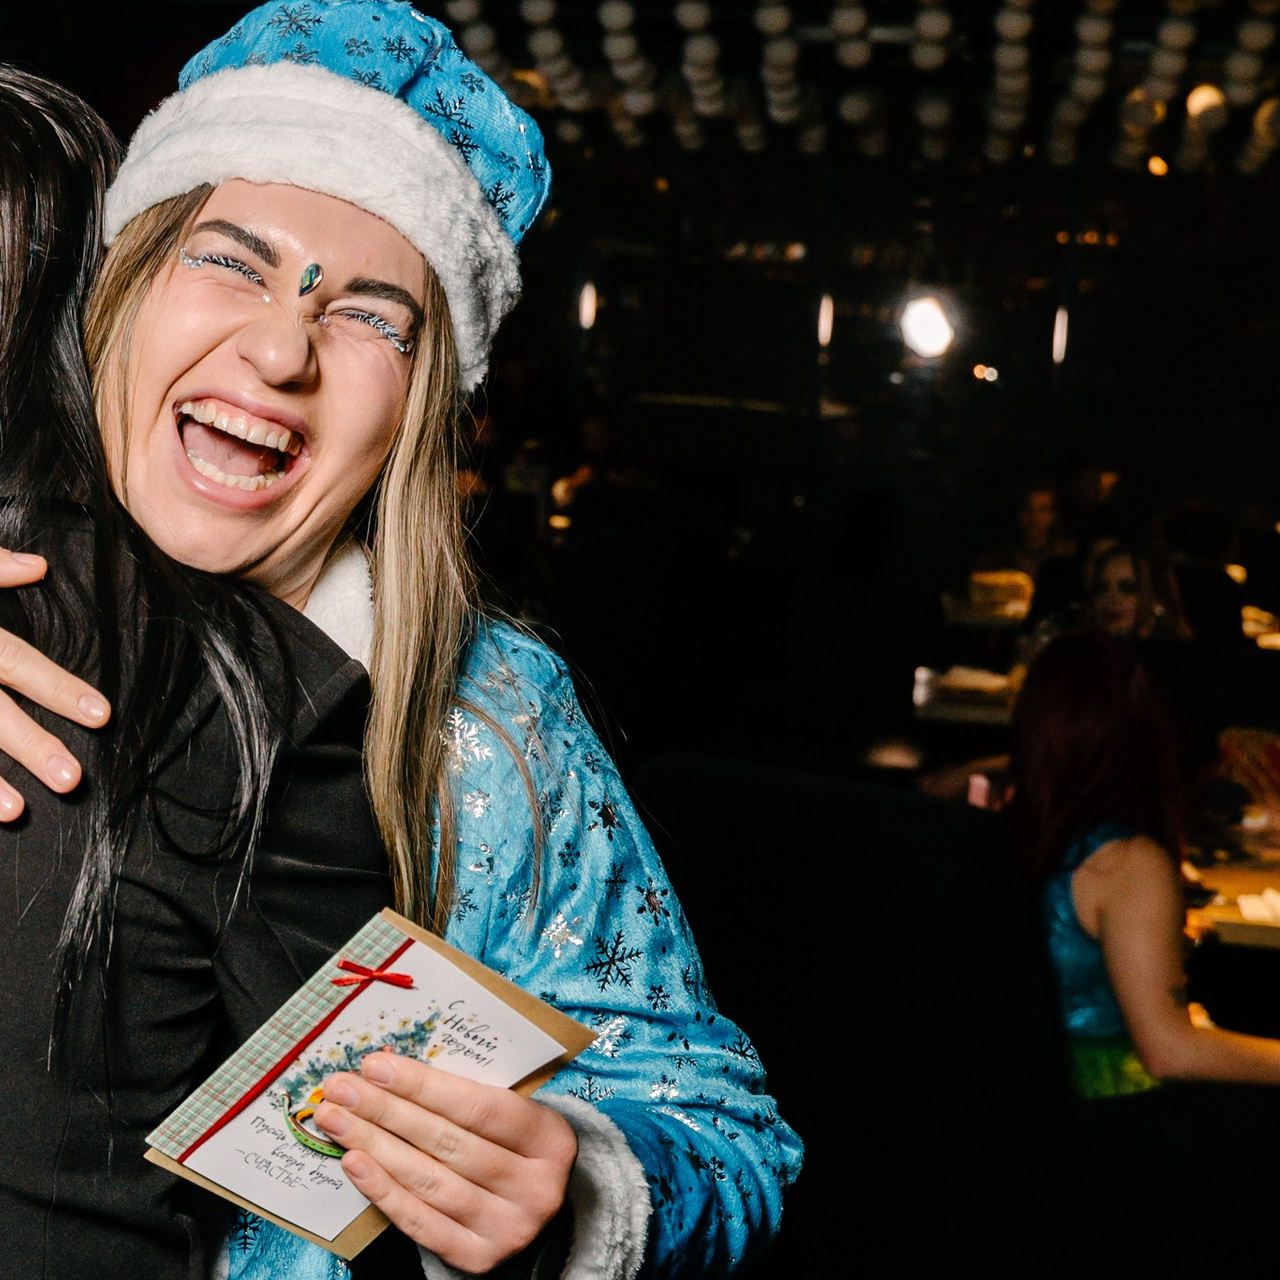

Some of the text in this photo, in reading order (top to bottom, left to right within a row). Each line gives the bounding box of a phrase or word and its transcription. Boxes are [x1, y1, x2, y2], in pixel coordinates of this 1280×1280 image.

[441, 1033, 494, 1068] годом!
[443, 1014, 497, 1052] Новым
[250, 1116, 287, 1141] Пусть
[271, 1143, 344, 1190] всегда будет
